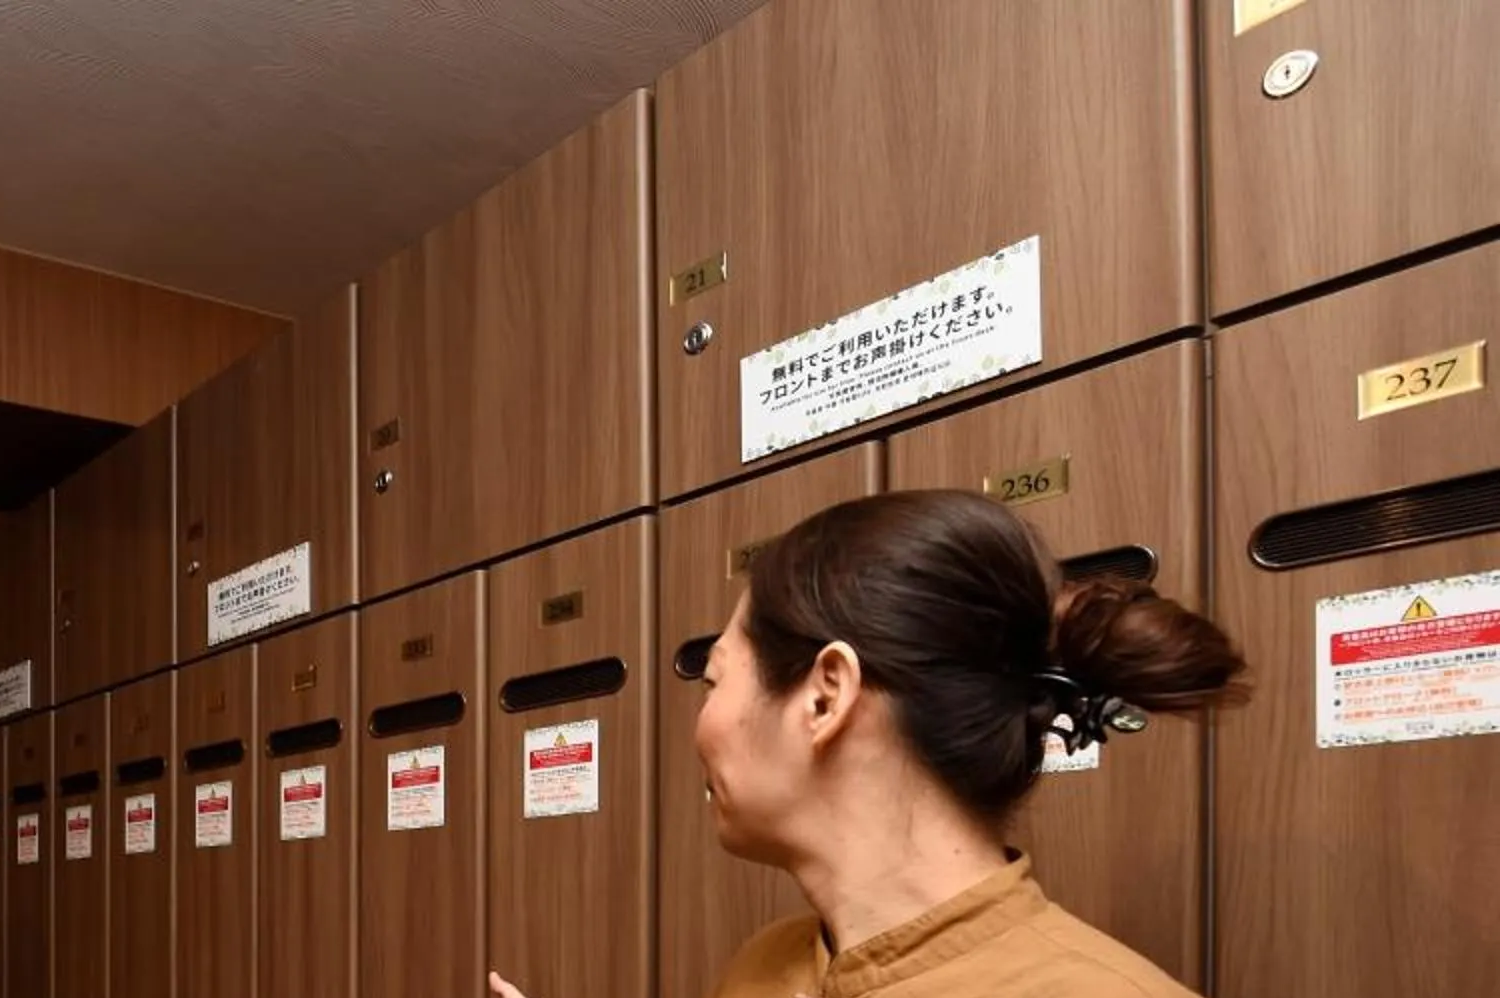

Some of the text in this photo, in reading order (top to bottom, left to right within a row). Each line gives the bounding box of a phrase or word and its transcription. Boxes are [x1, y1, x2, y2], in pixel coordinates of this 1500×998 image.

[759, 303, 1013, 405] フロントまでお声掛けください。
[771, 286, 996, 382] 無料でご利用いただけます。
[1384, 358, 1460, 402] 237
[1001, 467, 1050, 502] 236
